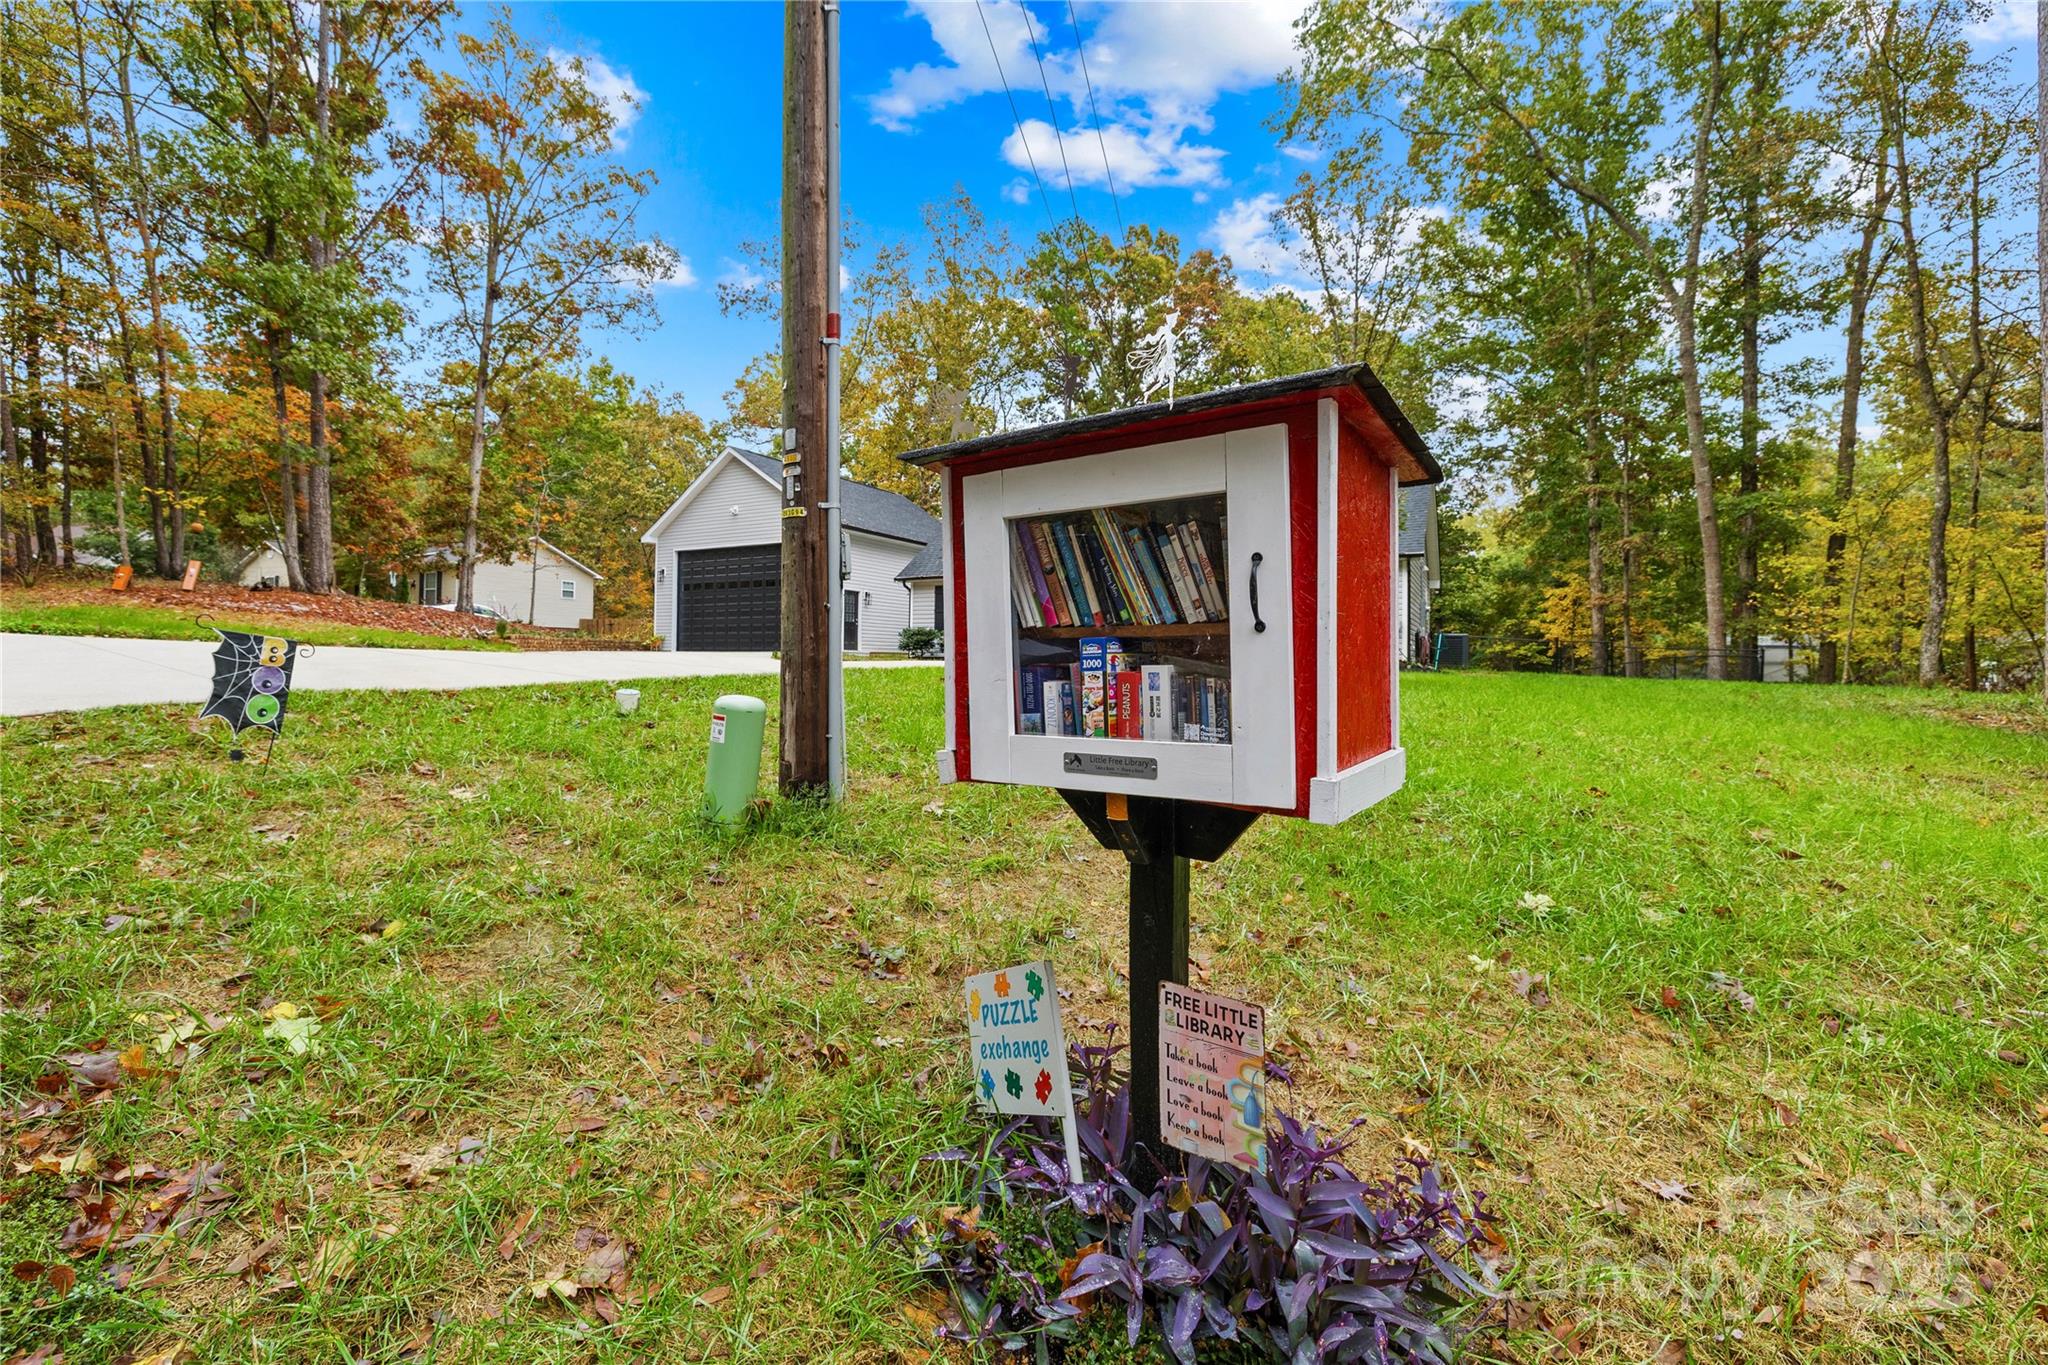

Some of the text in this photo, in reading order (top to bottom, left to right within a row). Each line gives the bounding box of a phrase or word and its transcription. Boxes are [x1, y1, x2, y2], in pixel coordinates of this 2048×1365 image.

[1082, 659, 1102, 668] 1000
[1122, 682, 1131, 720] PEANUTS
[1089, 755, 1107, 764] Little
[1108, 757, 1123, 766] Free
[1124, 758, 1149, 769] Library
[982, 998, 1039, 1028] PUZZLE
[1165, 991, 1258, 1029] FREE LITTLE
[1176, 1013, 1245, 1047] LIBRARY
[980, 1035, 1050, 1064] exchange
[1164, 1042, 1218, 1073] Take a book
[1166, 1066, 1228, 1100] Leave a book
[1167, 1089, 1224, 1122] Love a book
[1167, 1111, 1225, 1146] Keep a book
